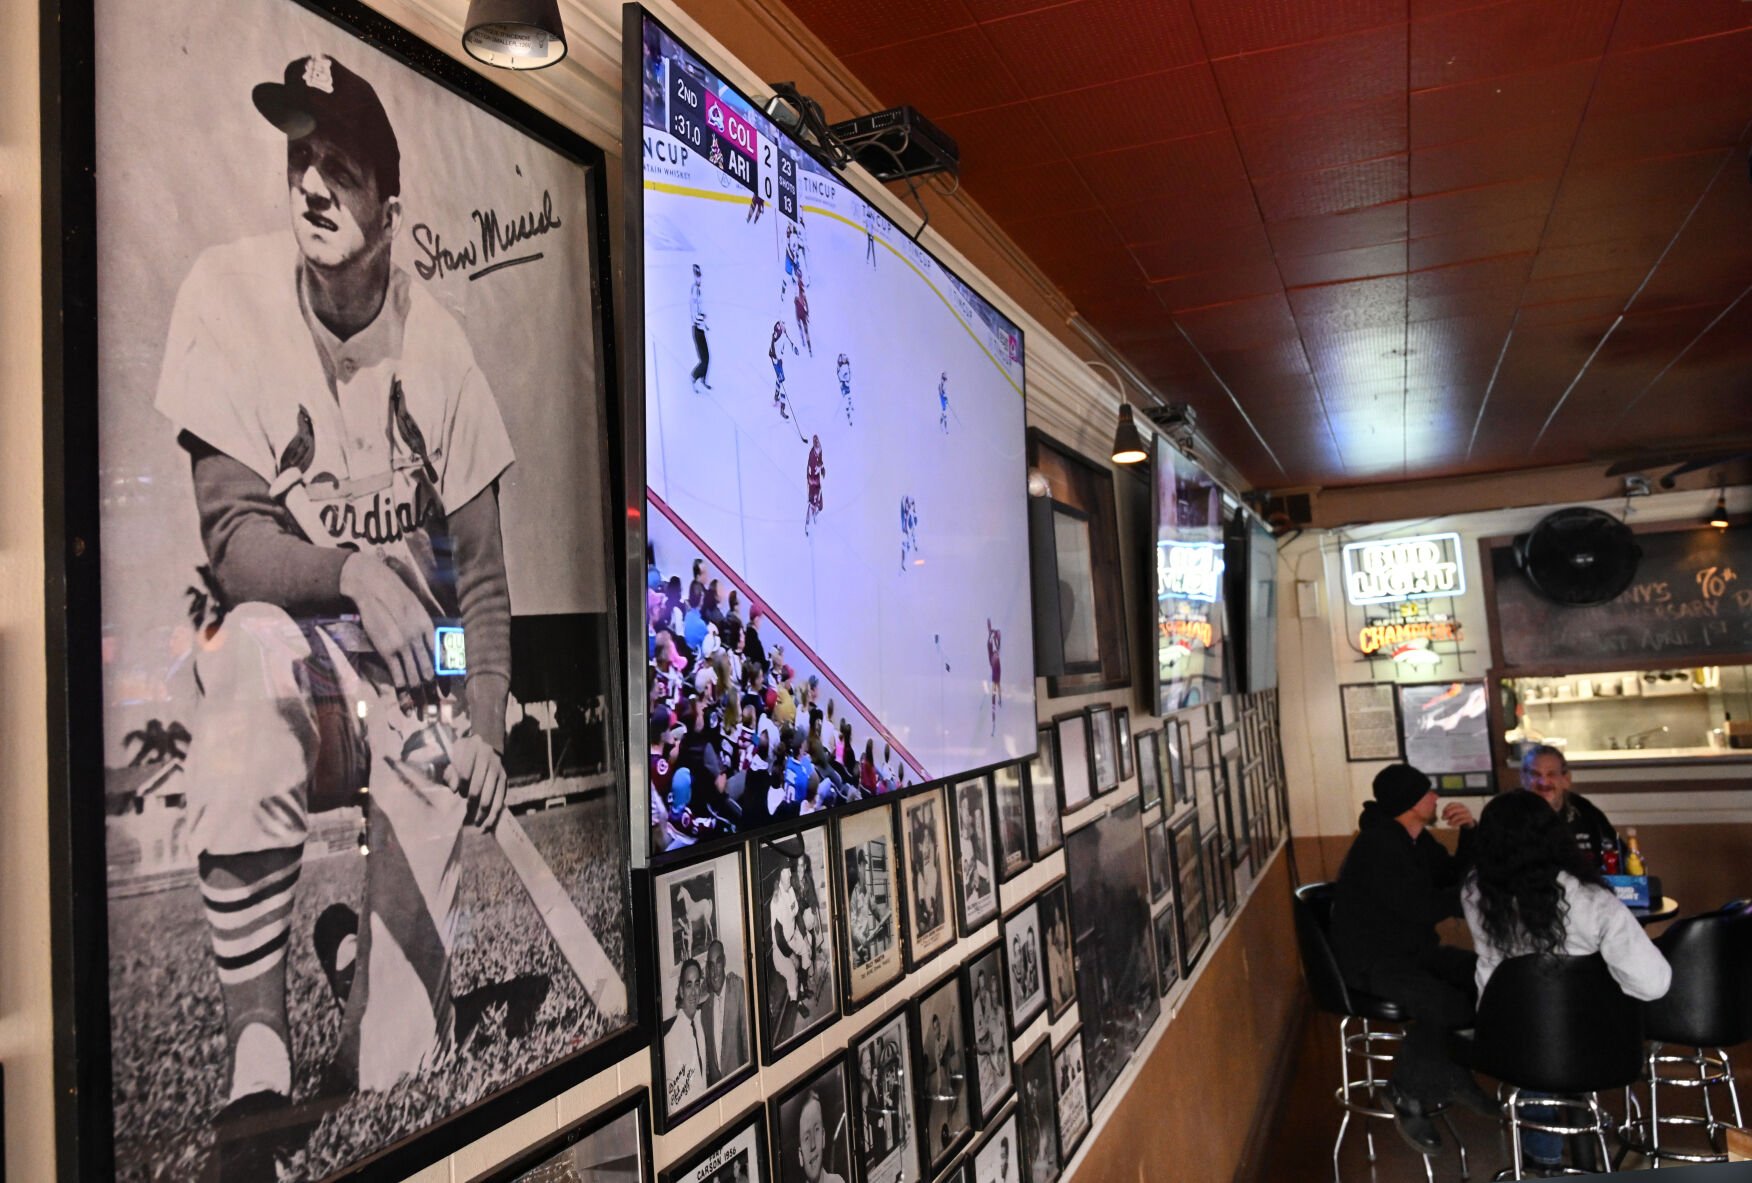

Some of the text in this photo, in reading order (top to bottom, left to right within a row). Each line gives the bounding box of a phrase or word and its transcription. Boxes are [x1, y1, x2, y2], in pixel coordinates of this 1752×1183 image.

[678, 78, 698, 108] 2ND
[674, 114, 700, 146] :31.0
[728, 117, 754, 153] COL
[644, 163, 690, 179] TAIN WHISKEY
[728, 150, 749, 183] ARI
[764, 144, 771, 168] 2
[781, 158, 791, 176] 23
[765, 176, 772, 199] 0
[779, 176, 795, 195] SHOTS
[803, 177, 835, 199] TINCUP
[783, 196, 792, 213] 13
[412, 223, 476, 280] Stan
[1363, 541, 1440, 573] BUD
[1352, 562, 1456, 598] LIGHT
[697, 1146, 736, 1180] CARSON 1956
